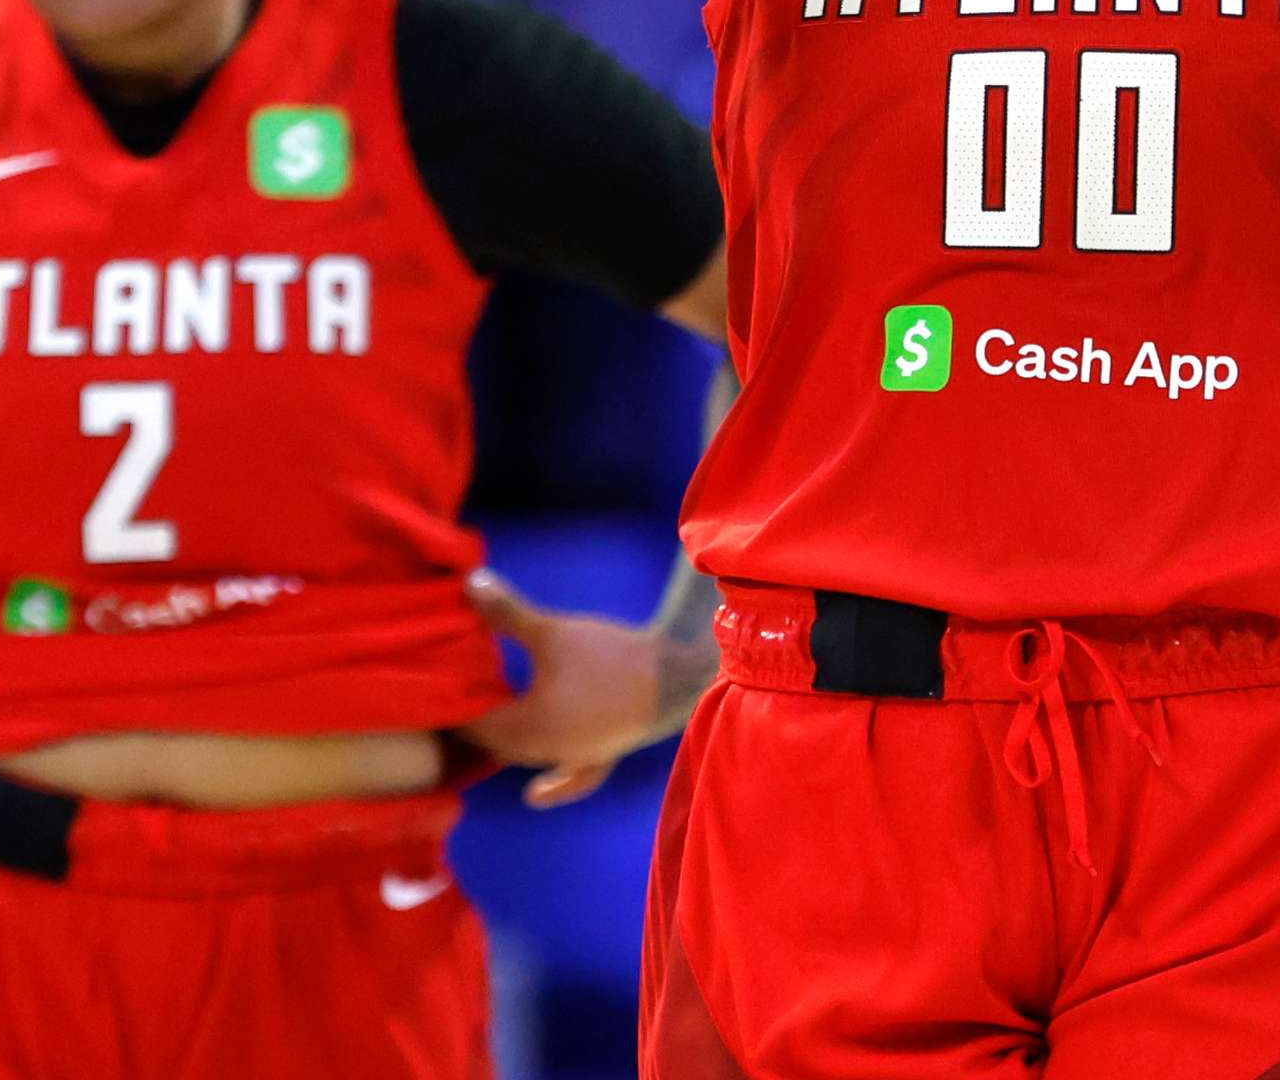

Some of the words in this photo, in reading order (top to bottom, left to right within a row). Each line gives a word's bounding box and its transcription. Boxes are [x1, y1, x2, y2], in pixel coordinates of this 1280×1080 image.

[943, 49, 1180, 253] 00
[974, 327, 1112, 385] Cash
[1123, 340, 1240, 401] App
[79, 381, 177, 564] 2
